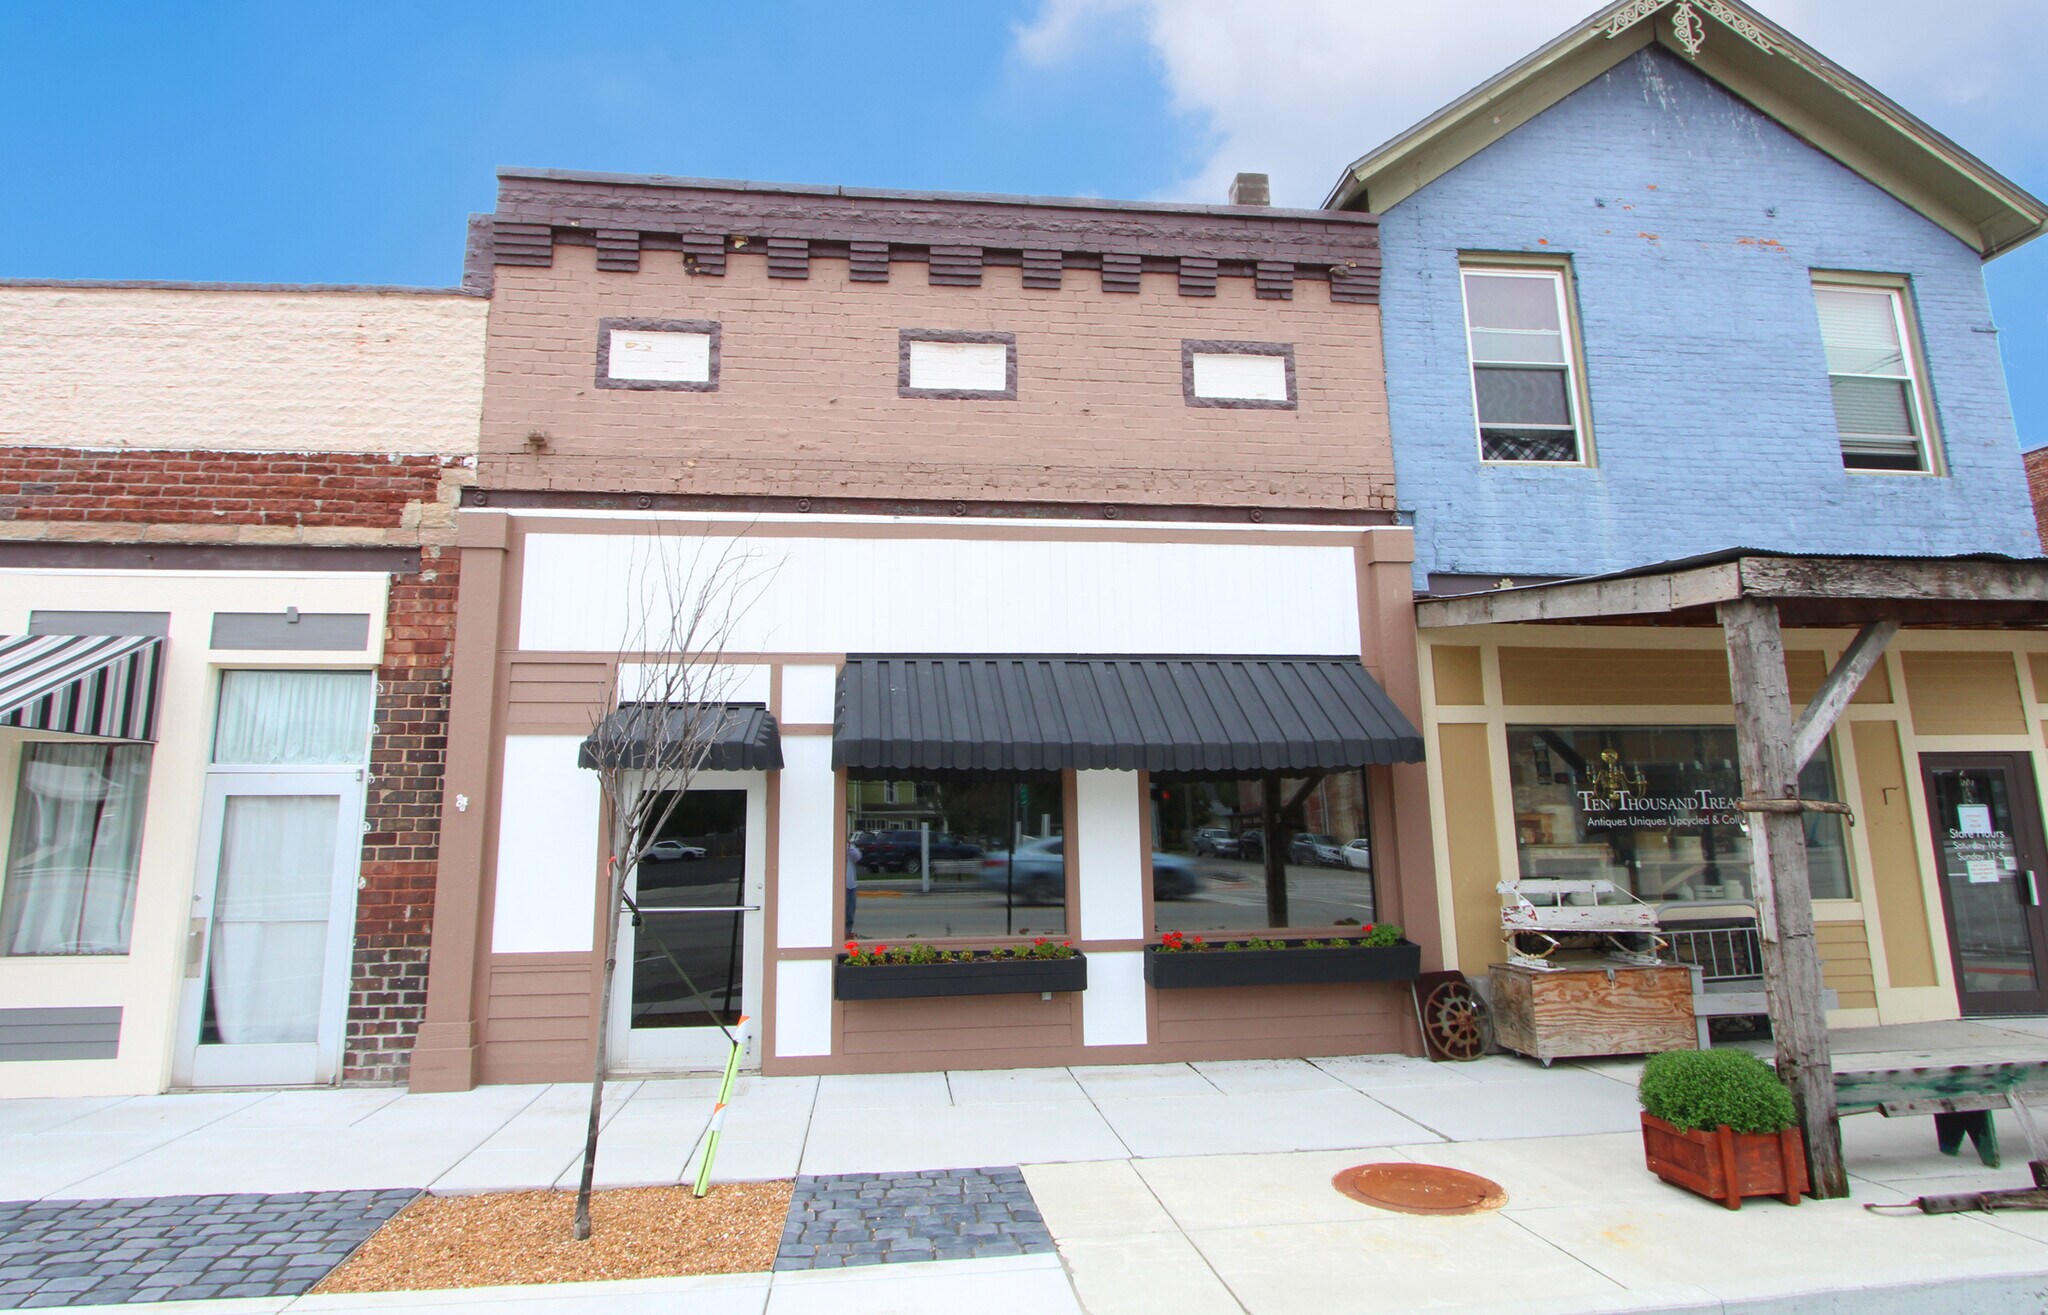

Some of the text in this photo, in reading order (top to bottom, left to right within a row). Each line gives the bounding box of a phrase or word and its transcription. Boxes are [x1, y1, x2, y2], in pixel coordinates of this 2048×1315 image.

[1577, 790, 1611, 811] TEN
[1614, 790, 1698, 811] THOUSAND
[1587, 817, 1627, 828] Antiques
[1629, 816, 1666, 828] Uniques
[1669, 815, 1709, 827] Upcycled
[1712, 815, 1719, 826] &
[1949, 828, 1974, 839] Store
[1953, 841, 2005, 851] Saturday 10-6
[1957, 851, 2004, 861] Sunday 11-5
